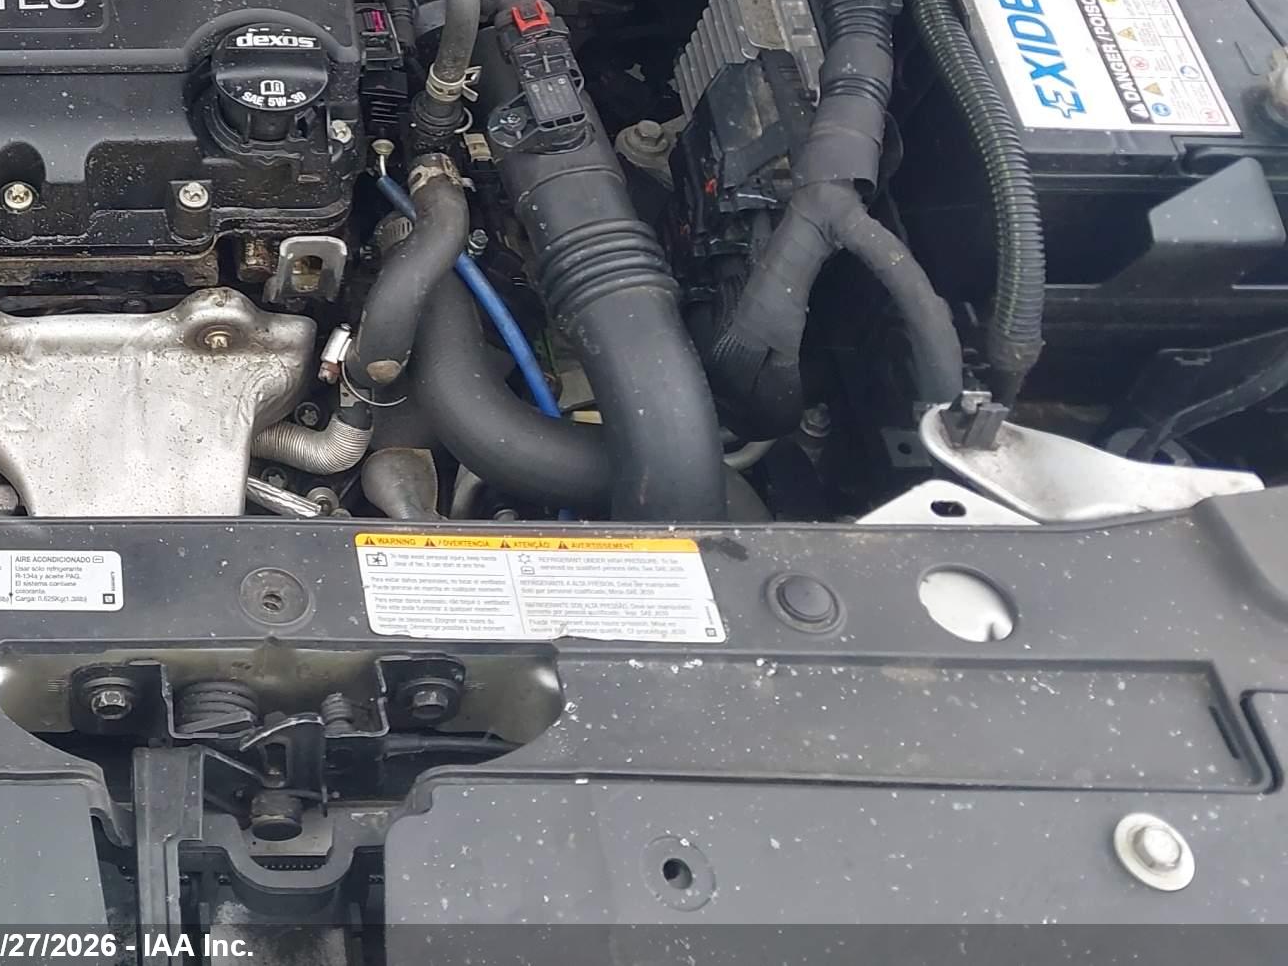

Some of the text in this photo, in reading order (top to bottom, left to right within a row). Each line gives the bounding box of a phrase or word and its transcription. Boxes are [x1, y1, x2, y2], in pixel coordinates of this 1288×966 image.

[236, 32, 317, 48] dexos
[1101, 43, 1148, 102] DANGER
[242, 91, 307, 107] SAE 5W-30
[377, 537, 416, 546] WARNING
[15, 555, 91, 563] AIRE ACONDICIONADO
